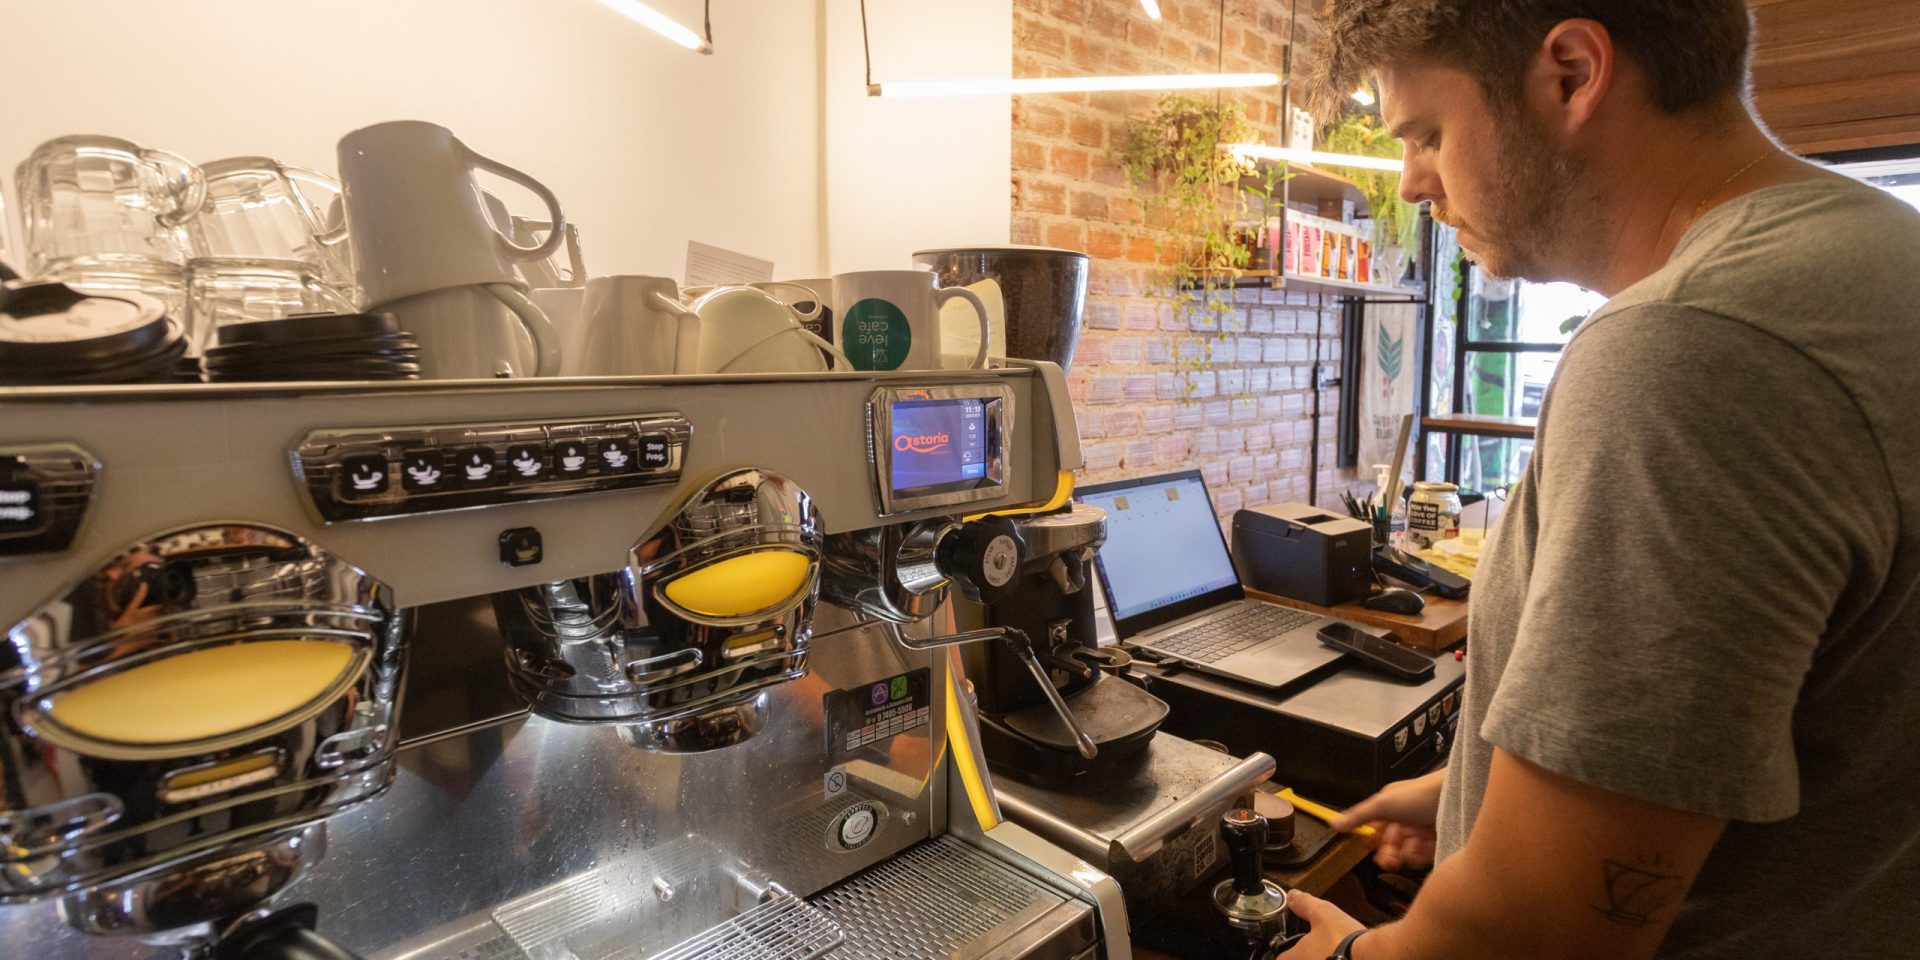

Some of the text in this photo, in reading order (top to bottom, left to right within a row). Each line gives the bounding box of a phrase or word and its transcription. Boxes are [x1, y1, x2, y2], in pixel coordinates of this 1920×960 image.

[859, 335, 888, 346] leve
[646, 443, 664, 451] Stop
[646, 453, 665, 461] Prog.
